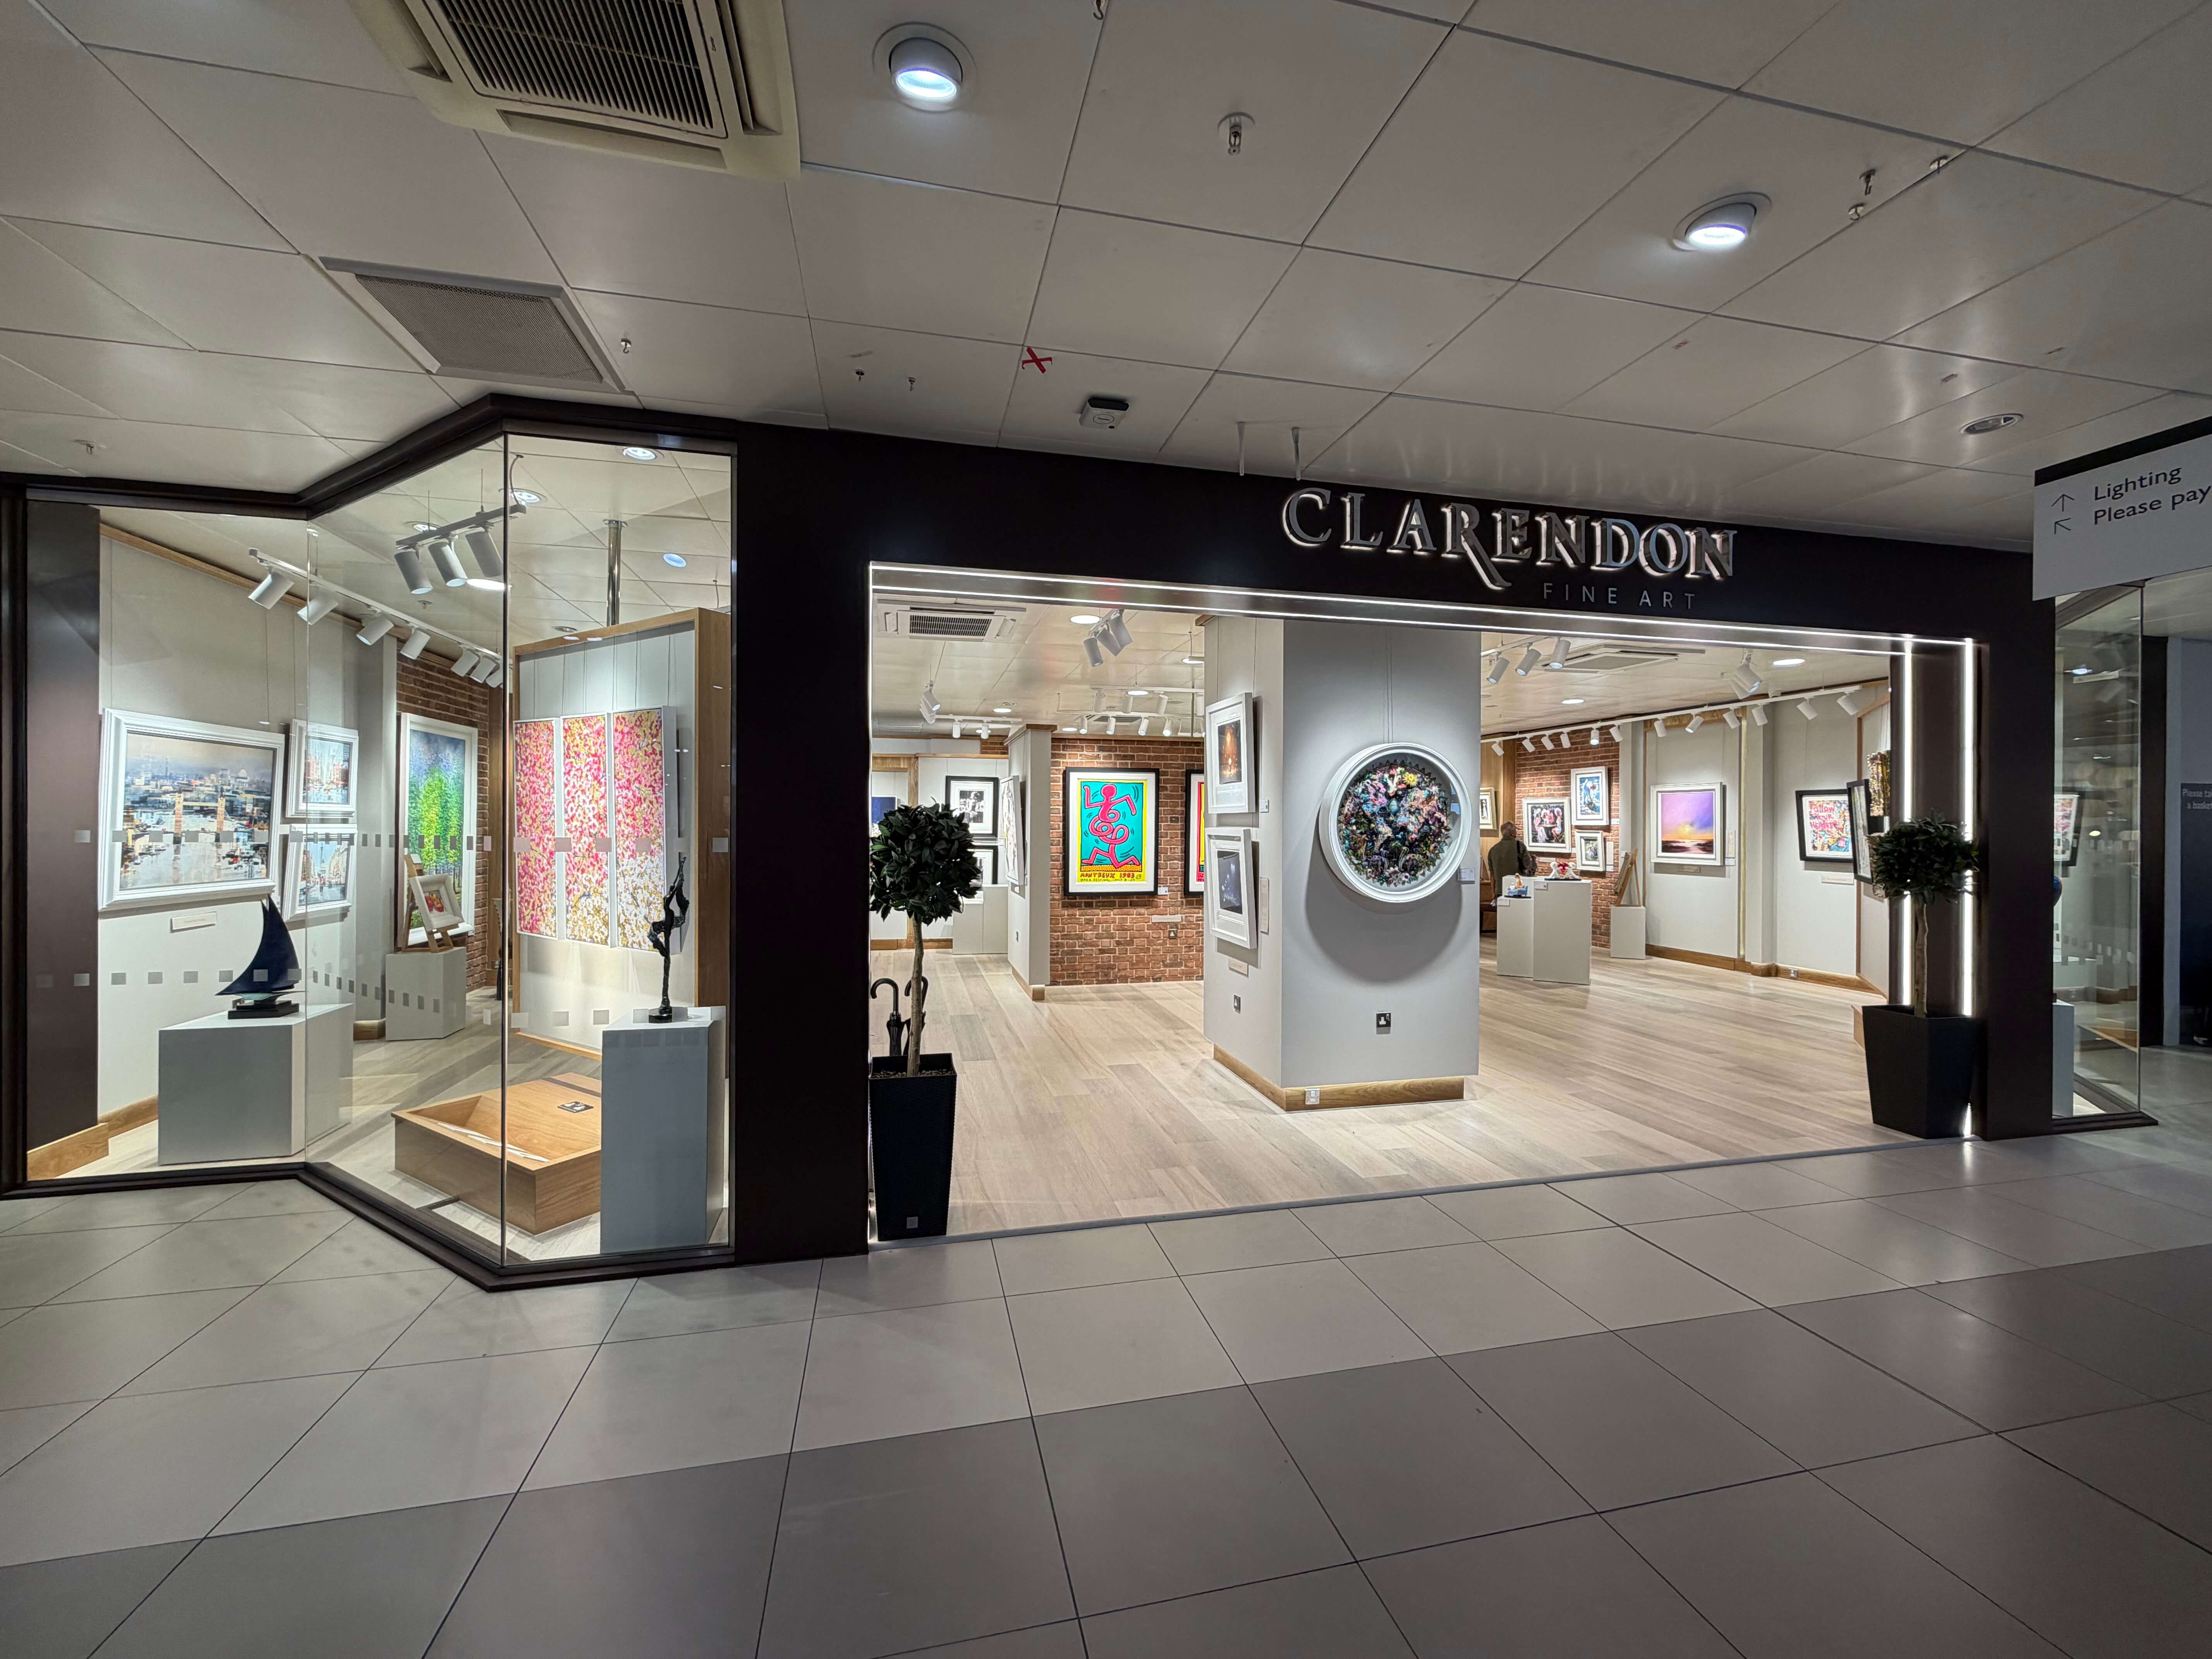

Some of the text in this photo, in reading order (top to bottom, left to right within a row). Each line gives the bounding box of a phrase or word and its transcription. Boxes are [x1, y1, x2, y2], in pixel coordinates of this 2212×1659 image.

[2094, 467, 2181, 501] Lighting
[2094, 486, 2212, 525] Please pay
[1283, 487, 1738, 590] CLARENDON
[1544, 583, 1695, 609] FINE ART
